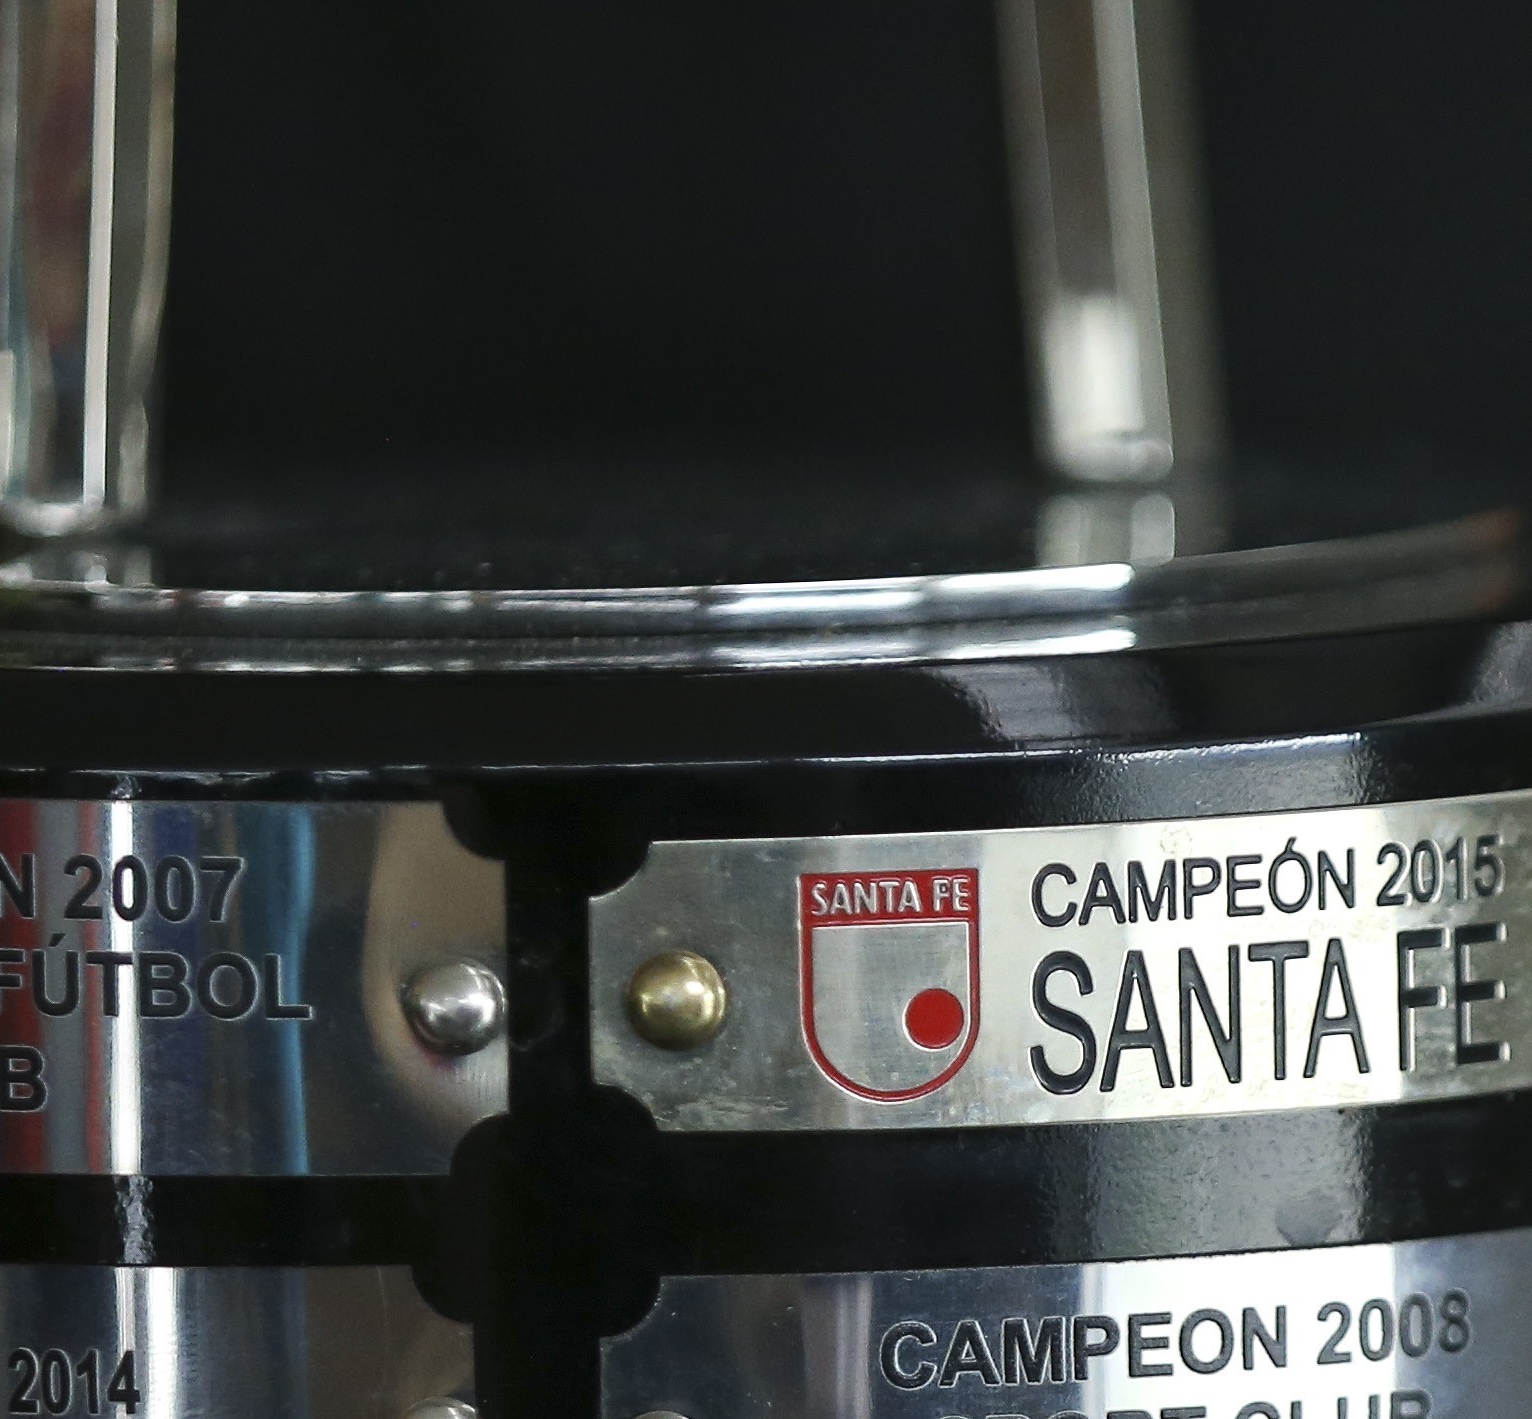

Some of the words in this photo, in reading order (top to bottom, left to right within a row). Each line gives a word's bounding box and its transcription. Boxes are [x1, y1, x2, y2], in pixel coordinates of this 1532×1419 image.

[62, 856, 245, 922] 2007
[810, 880, 921, 916] SANTA
[1030, 837, 1357, 927] CAMPEÓN
[1376, 835, 1504, 907] 2015
[1028, 937, 1369, 1095] SANTA
[1396, 922, 1512, 1072] FE
[878, 1307, 1288, 1389] CAMPEON
[1316, 1291, 1472, 1366] 2008
[7, 1346, 140, 1415] 2014
